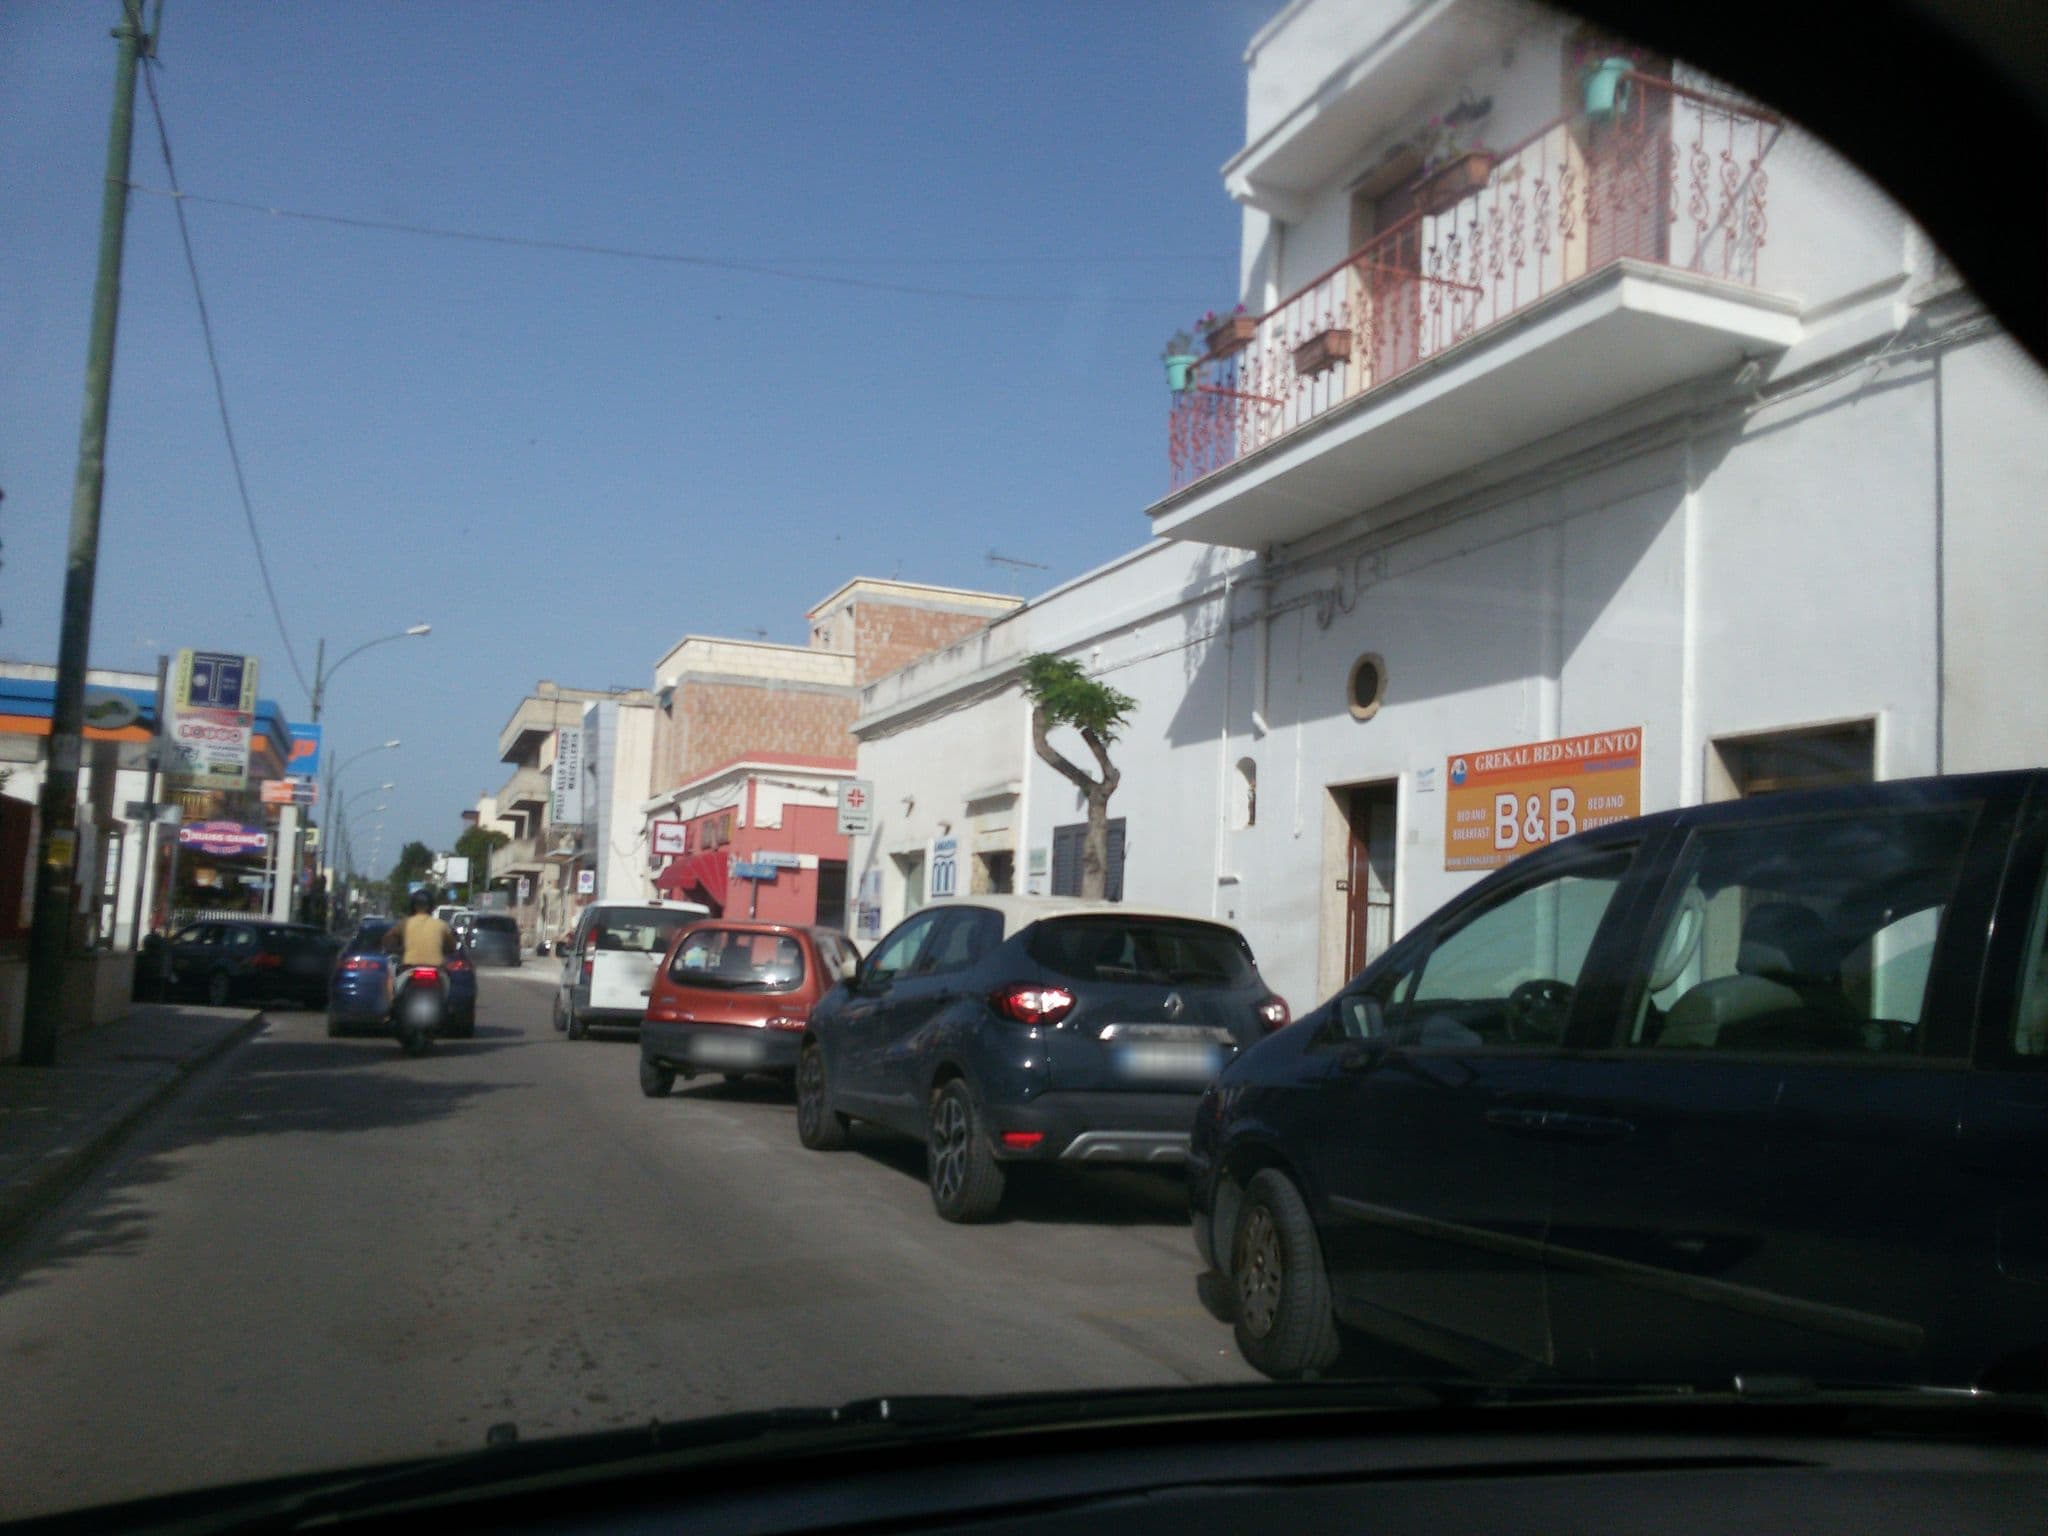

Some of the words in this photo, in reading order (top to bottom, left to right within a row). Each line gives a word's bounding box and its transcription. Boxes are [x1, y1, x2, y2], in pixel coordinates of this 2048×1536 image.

[1475, 751, 1530, 772] GREKAL
[1534, 746, 1561, 762] BED
[1565, 732, 1638, 758] SALENTO
[1588, 797, 1603, 810] BED
[1606, 795, 1623, 808] AND
[1494, 786, 1577, 850] B&B
[1453, 827, 1489, 841] BREAKFAST
